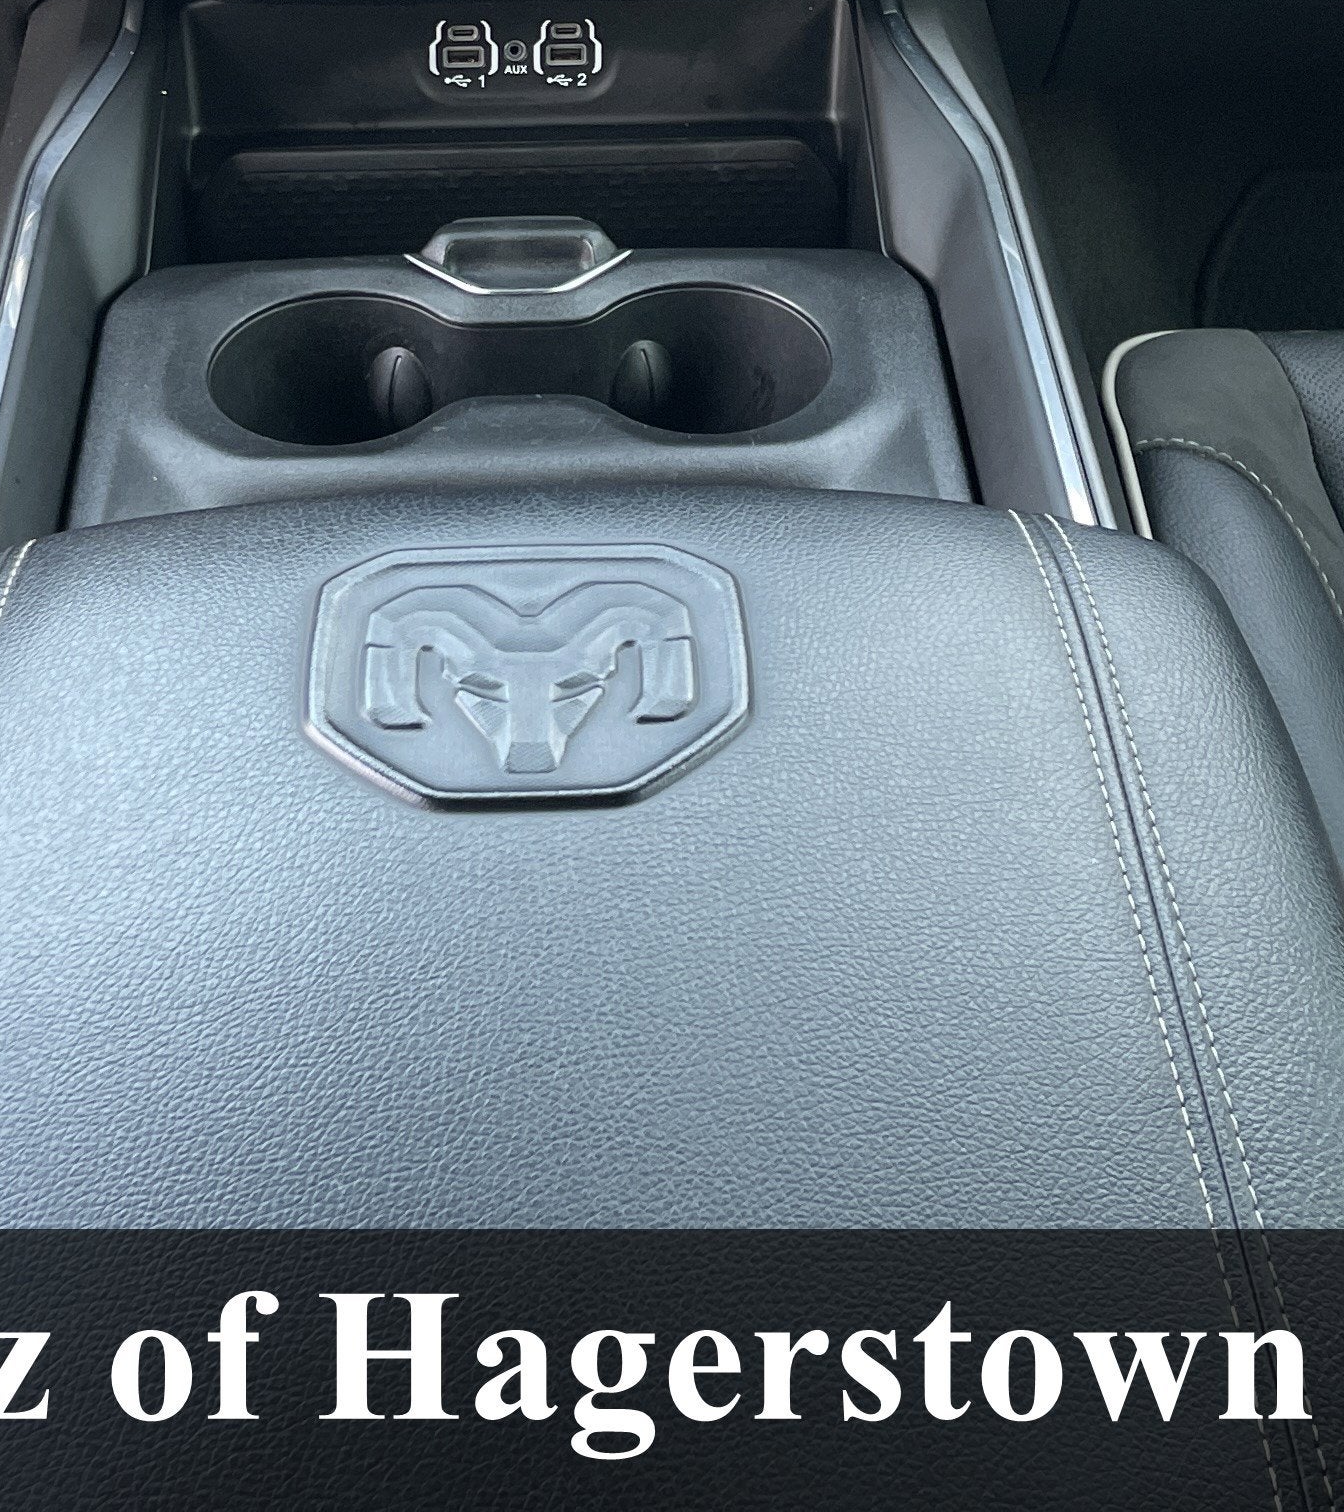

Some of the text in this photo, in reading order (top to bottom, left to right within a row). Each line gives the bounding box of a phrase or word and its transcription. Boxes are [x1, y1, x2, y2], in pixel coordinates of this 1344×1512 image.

[504, 64, 528, 75] AUX
[478, 75, 486, 89] 1
[577, 73, 587, 87] 2
